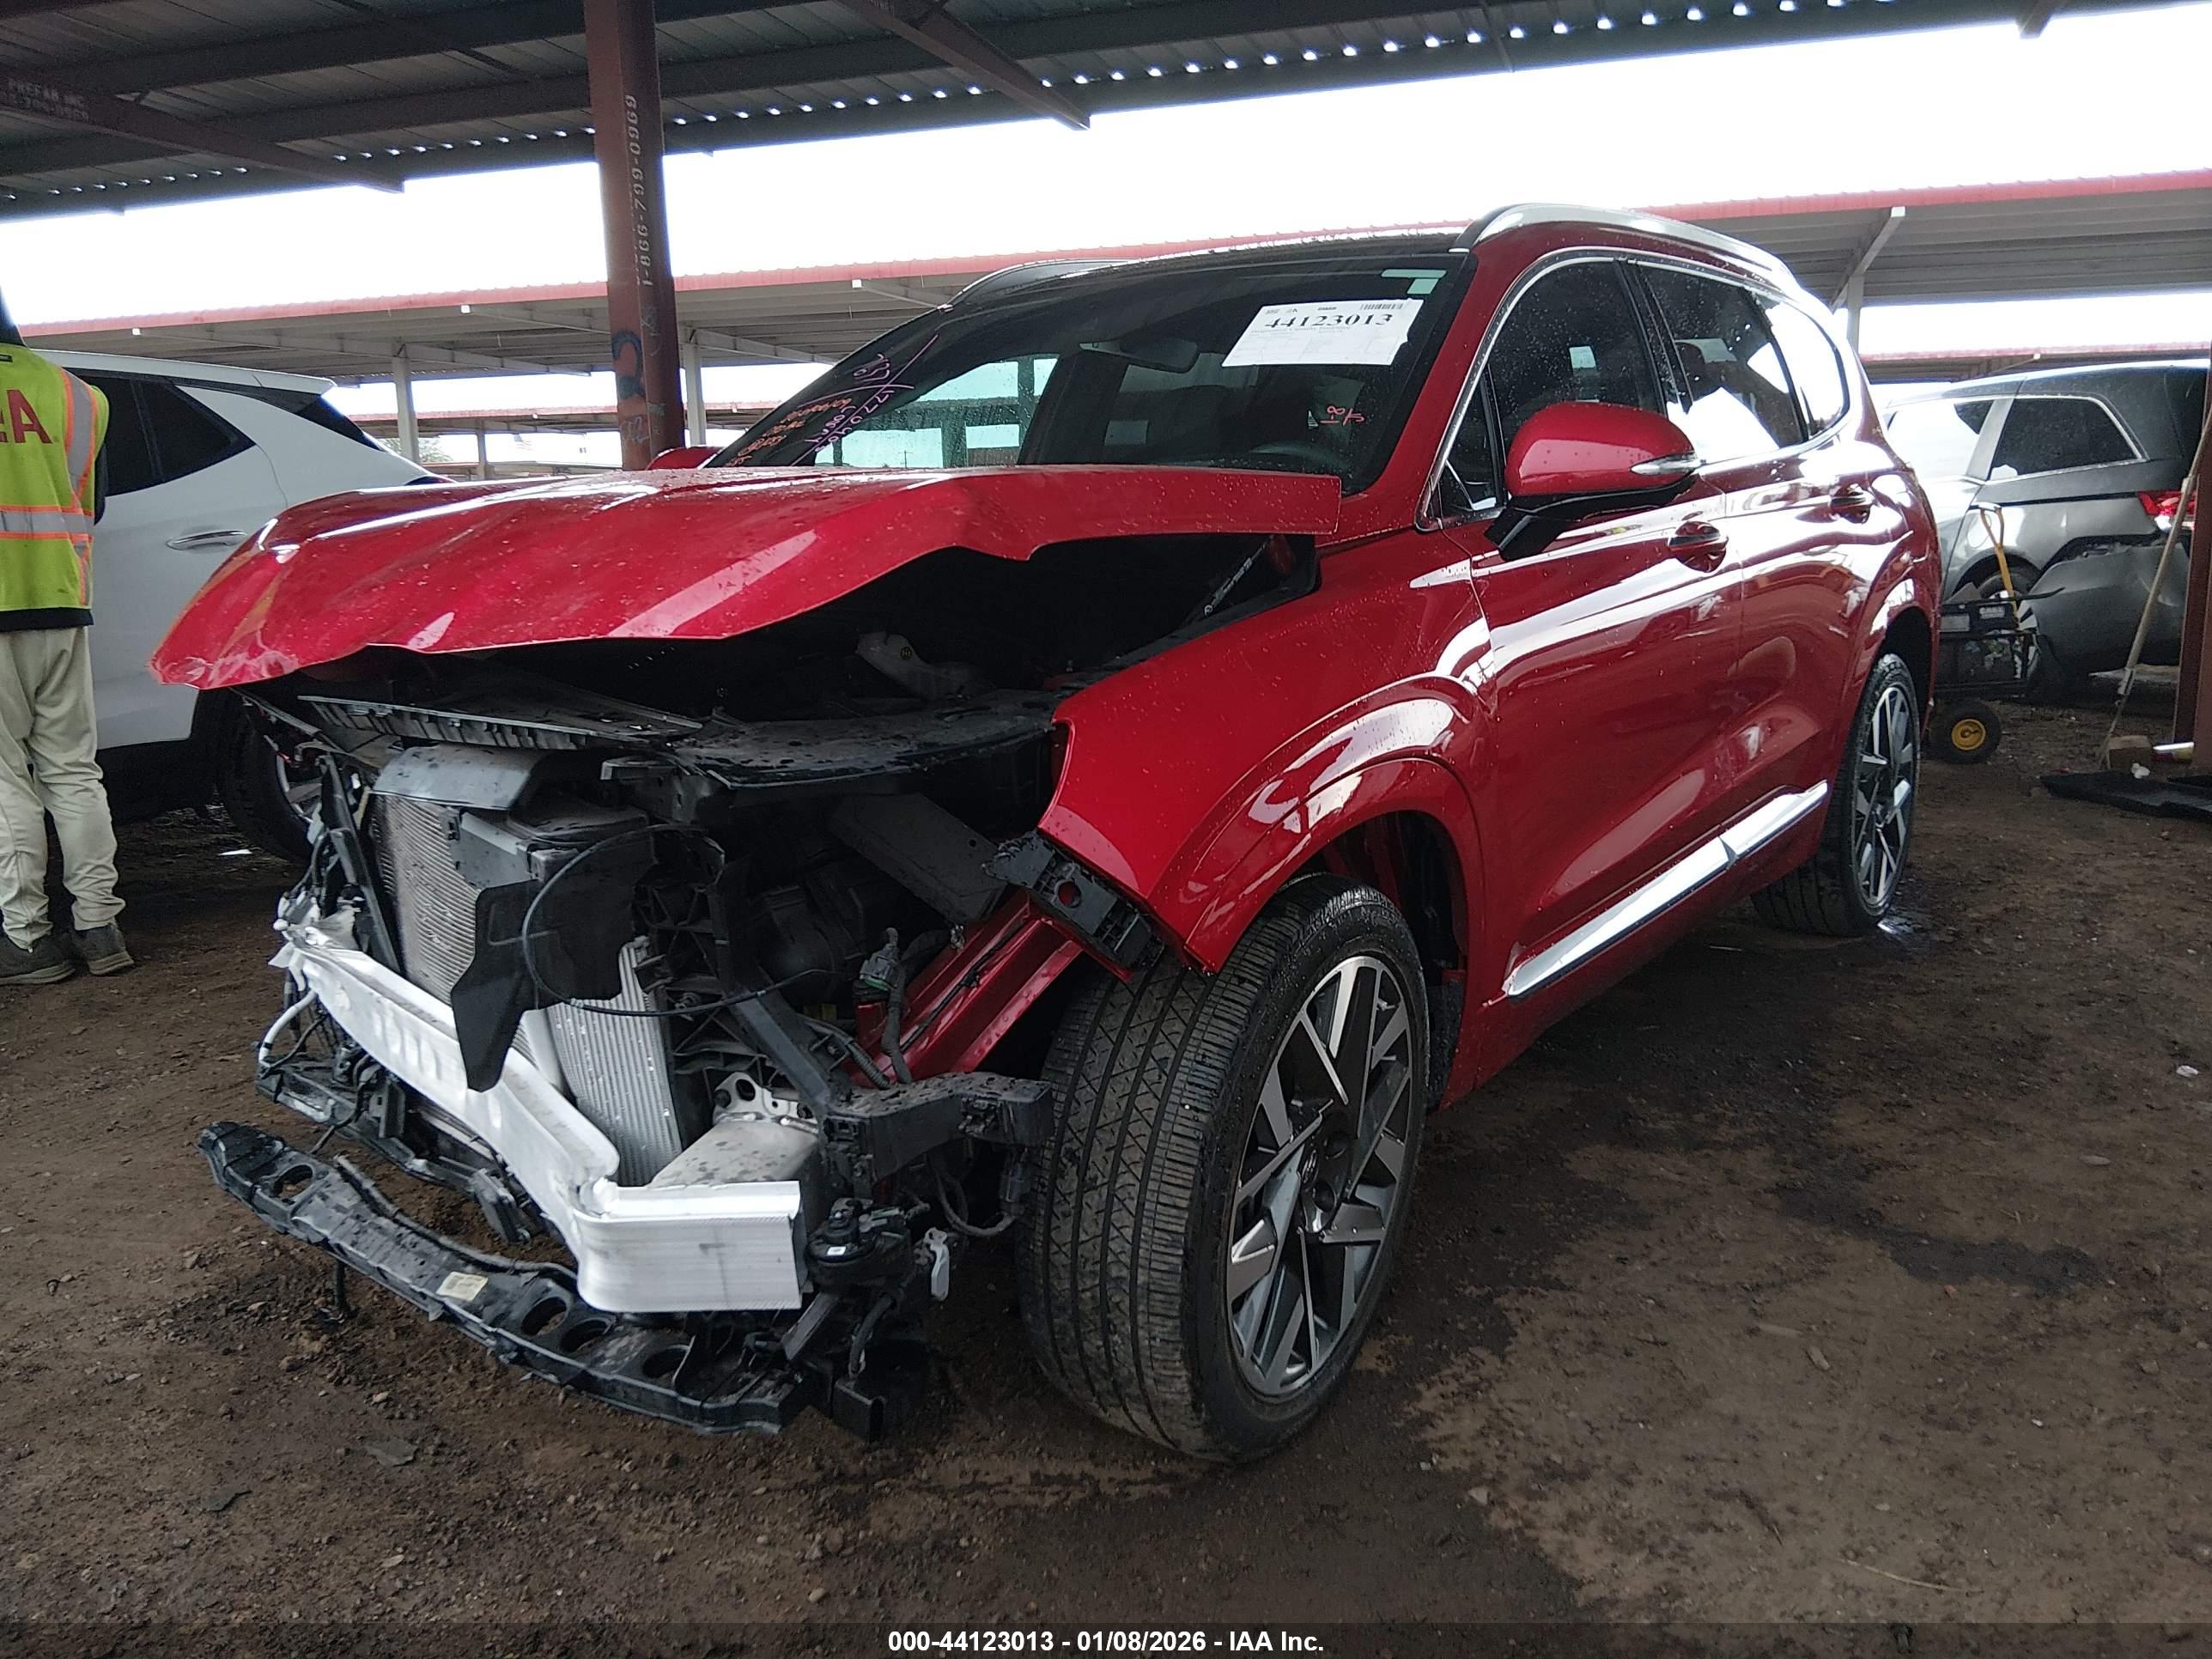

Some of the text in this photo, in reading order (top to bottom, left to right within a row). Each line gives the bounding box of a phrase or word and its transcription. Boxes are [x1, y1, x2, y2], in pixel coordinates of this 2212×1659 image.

[624, 94, 653, 287] 1-866-799-0969
[1264, 313, 1394, 328] 44123013
[0, 389, 53, 444] A
